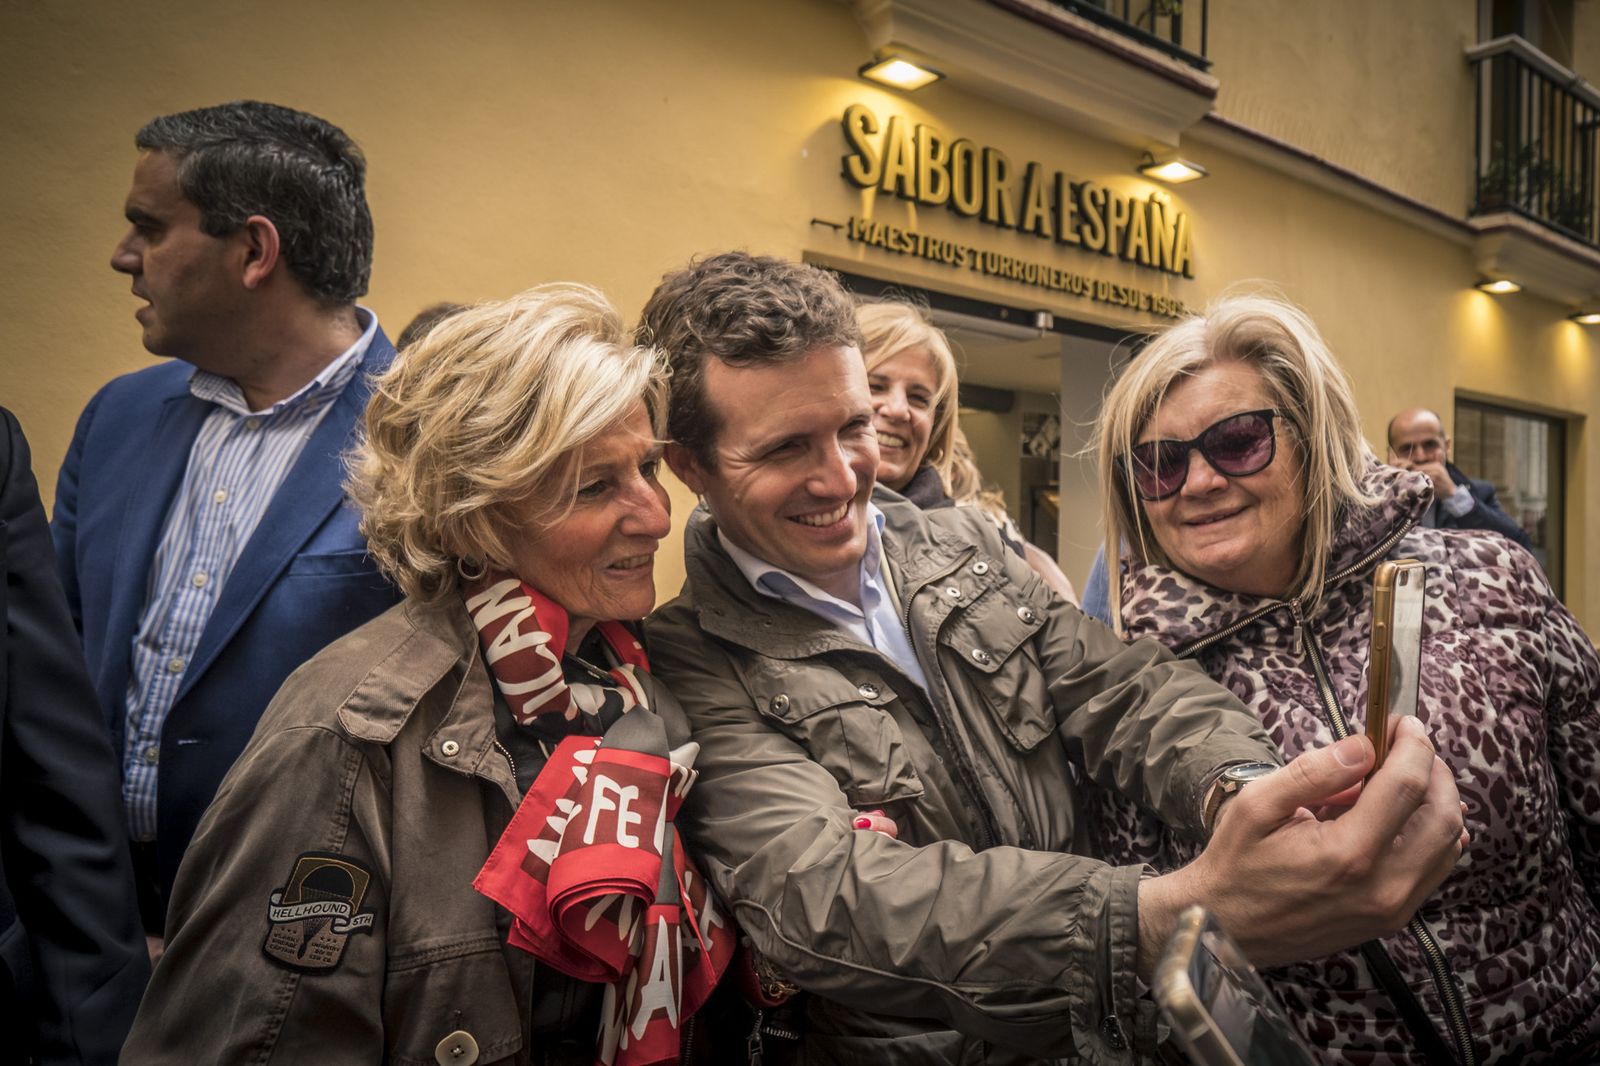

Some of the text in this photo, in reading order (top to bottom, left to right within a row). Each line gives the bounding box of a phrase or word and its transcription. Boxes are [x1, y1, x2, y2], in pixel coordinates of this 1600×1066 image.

[842, 104, 1196, 280] SABOR A ESPAÑA
[848, 216, 966, 268] MAESTROS
[970, 247, 1093, 297] TURRONEROS
[1096, 276, 1150, 312] DESDE
[272, 903, 348, 918] HELLHOUND
[352, 916, 372, 926] 5TH
